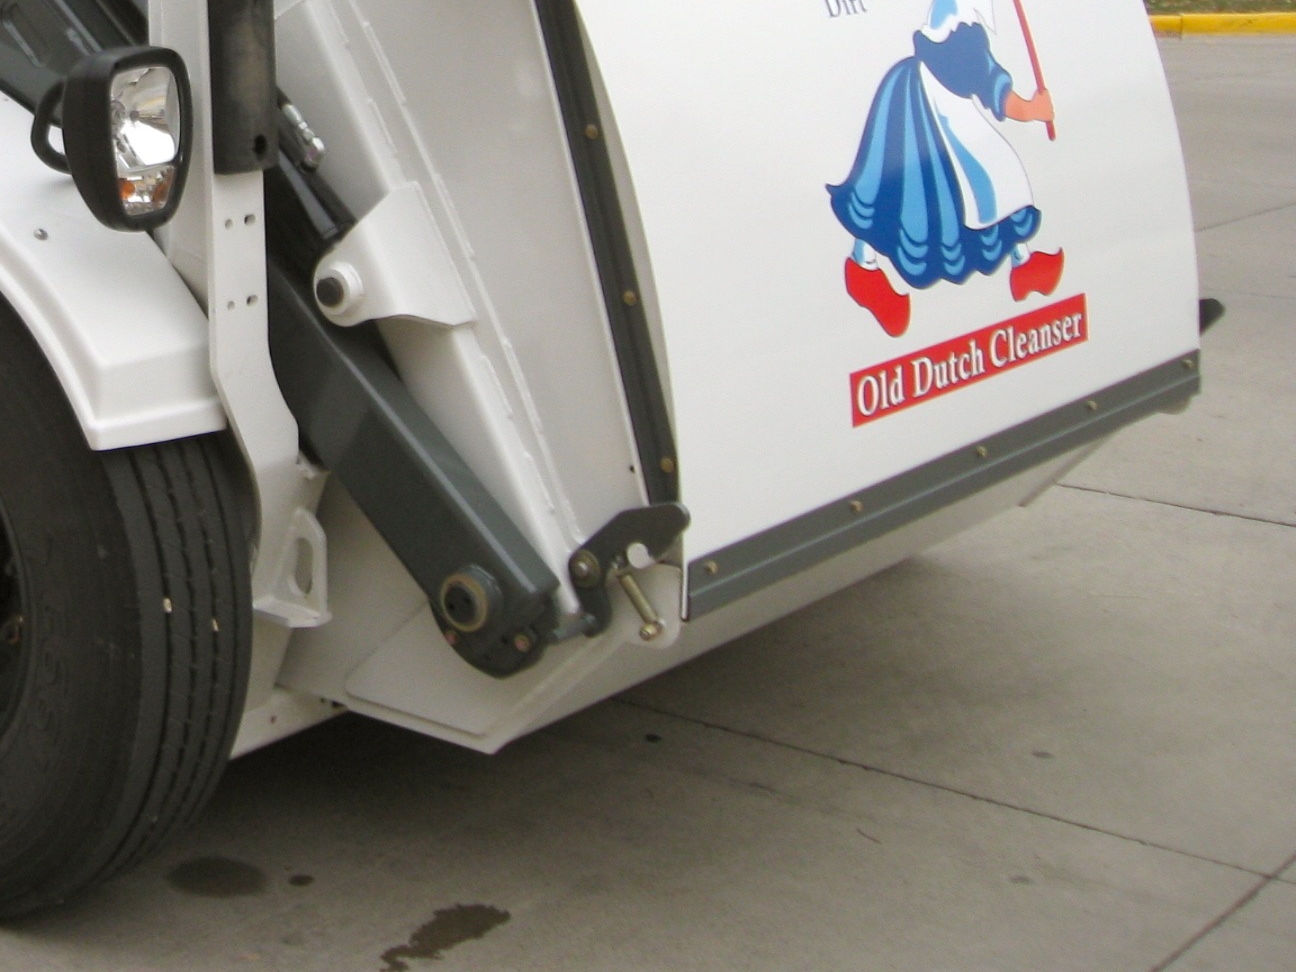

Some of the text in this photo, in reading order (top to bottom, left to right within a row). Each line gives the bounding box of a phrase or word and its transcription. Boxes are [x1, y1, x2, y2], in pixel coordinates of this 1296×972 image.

[856, 312, 1082, 417] Old Dutch Cleanser
